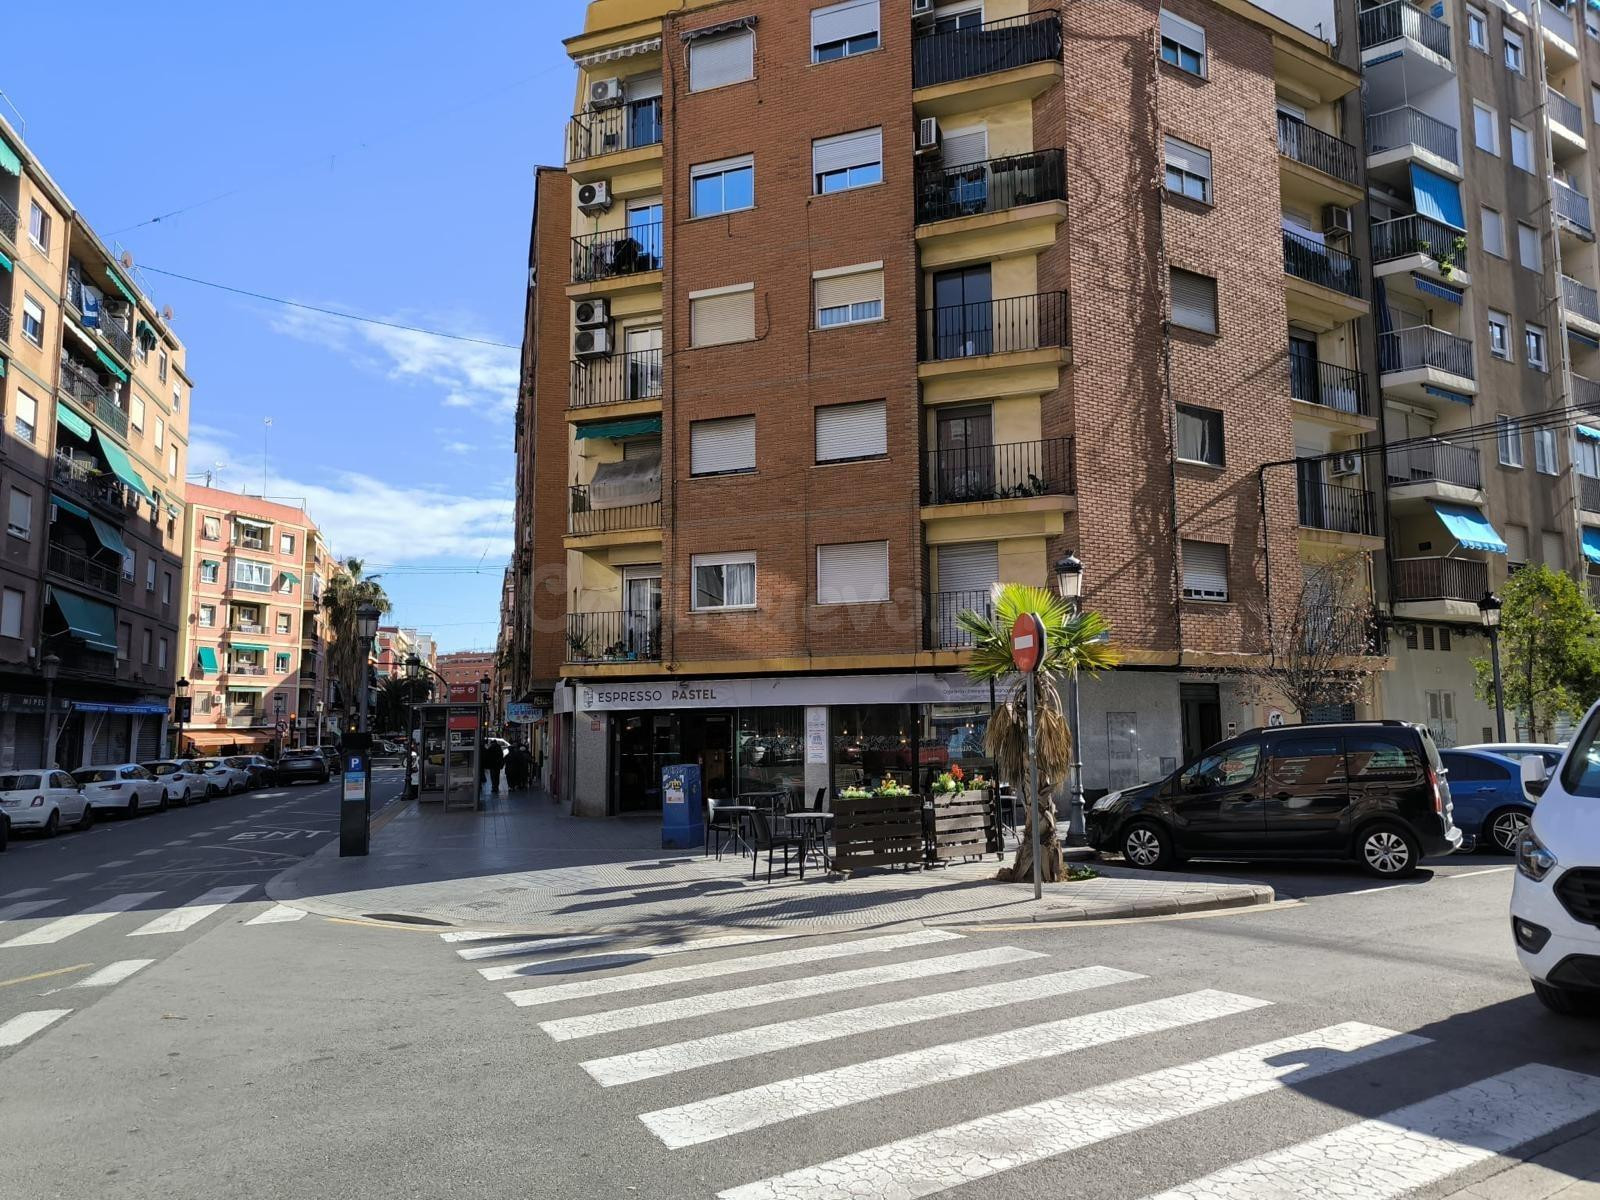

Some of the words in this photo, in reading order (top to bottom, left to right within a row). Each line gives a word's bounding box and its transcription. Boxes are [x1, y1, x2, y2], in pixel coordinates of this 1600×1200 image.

[598, 690, 663, 703] ESPRESSO
[671, 688, 717, 701] PASTEL
[351, 758, 361, 769] P
